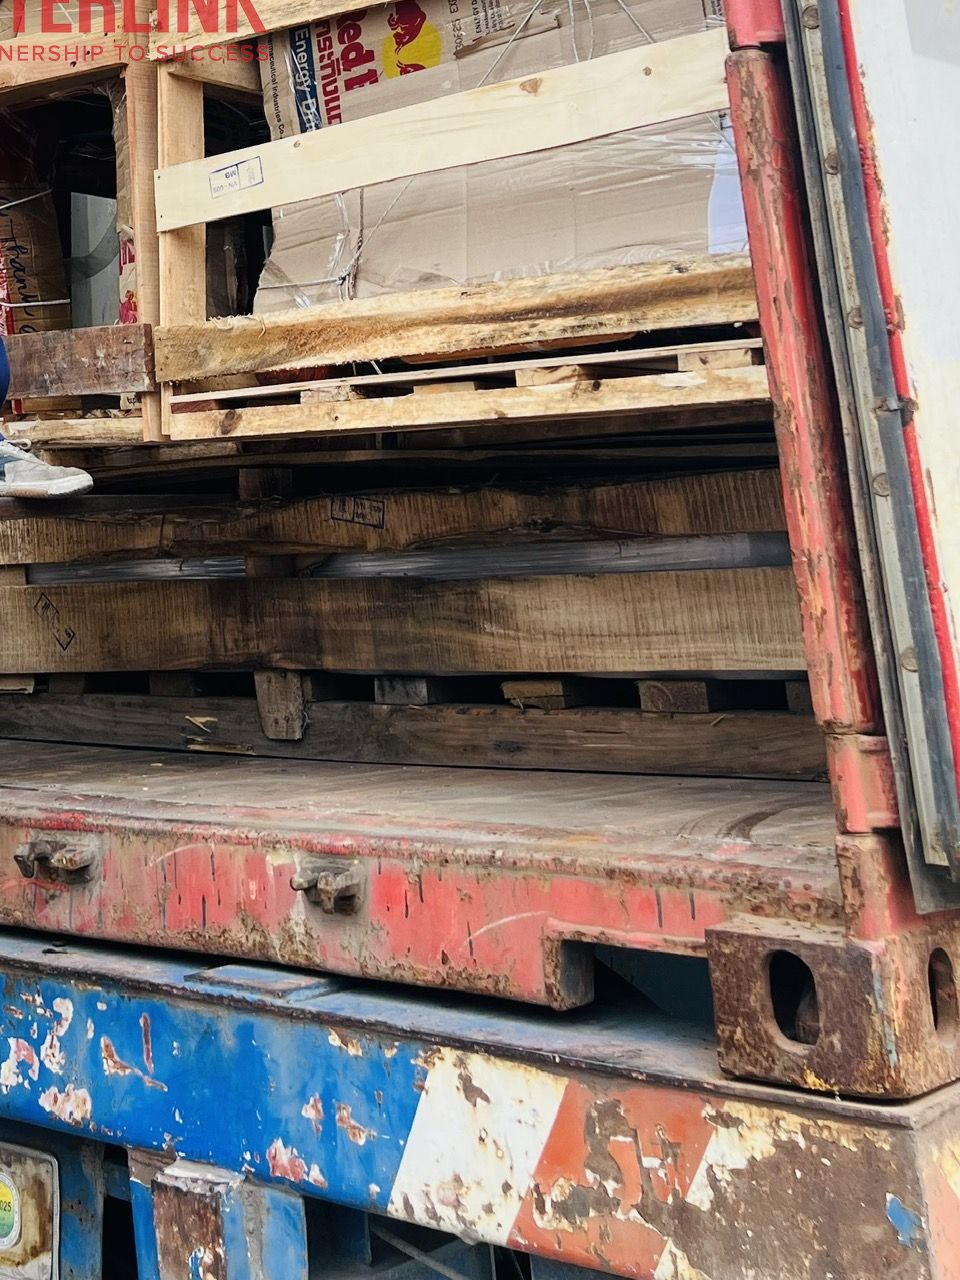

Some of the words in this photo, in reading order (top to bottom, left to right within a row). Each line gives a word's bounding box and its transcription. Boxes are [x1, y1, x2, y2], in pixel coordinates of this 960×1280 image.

[268, 36, 278, 86] armaceutical
[294, 27, 311, 92] Energy
[272, 86, 282, 122] Industries
